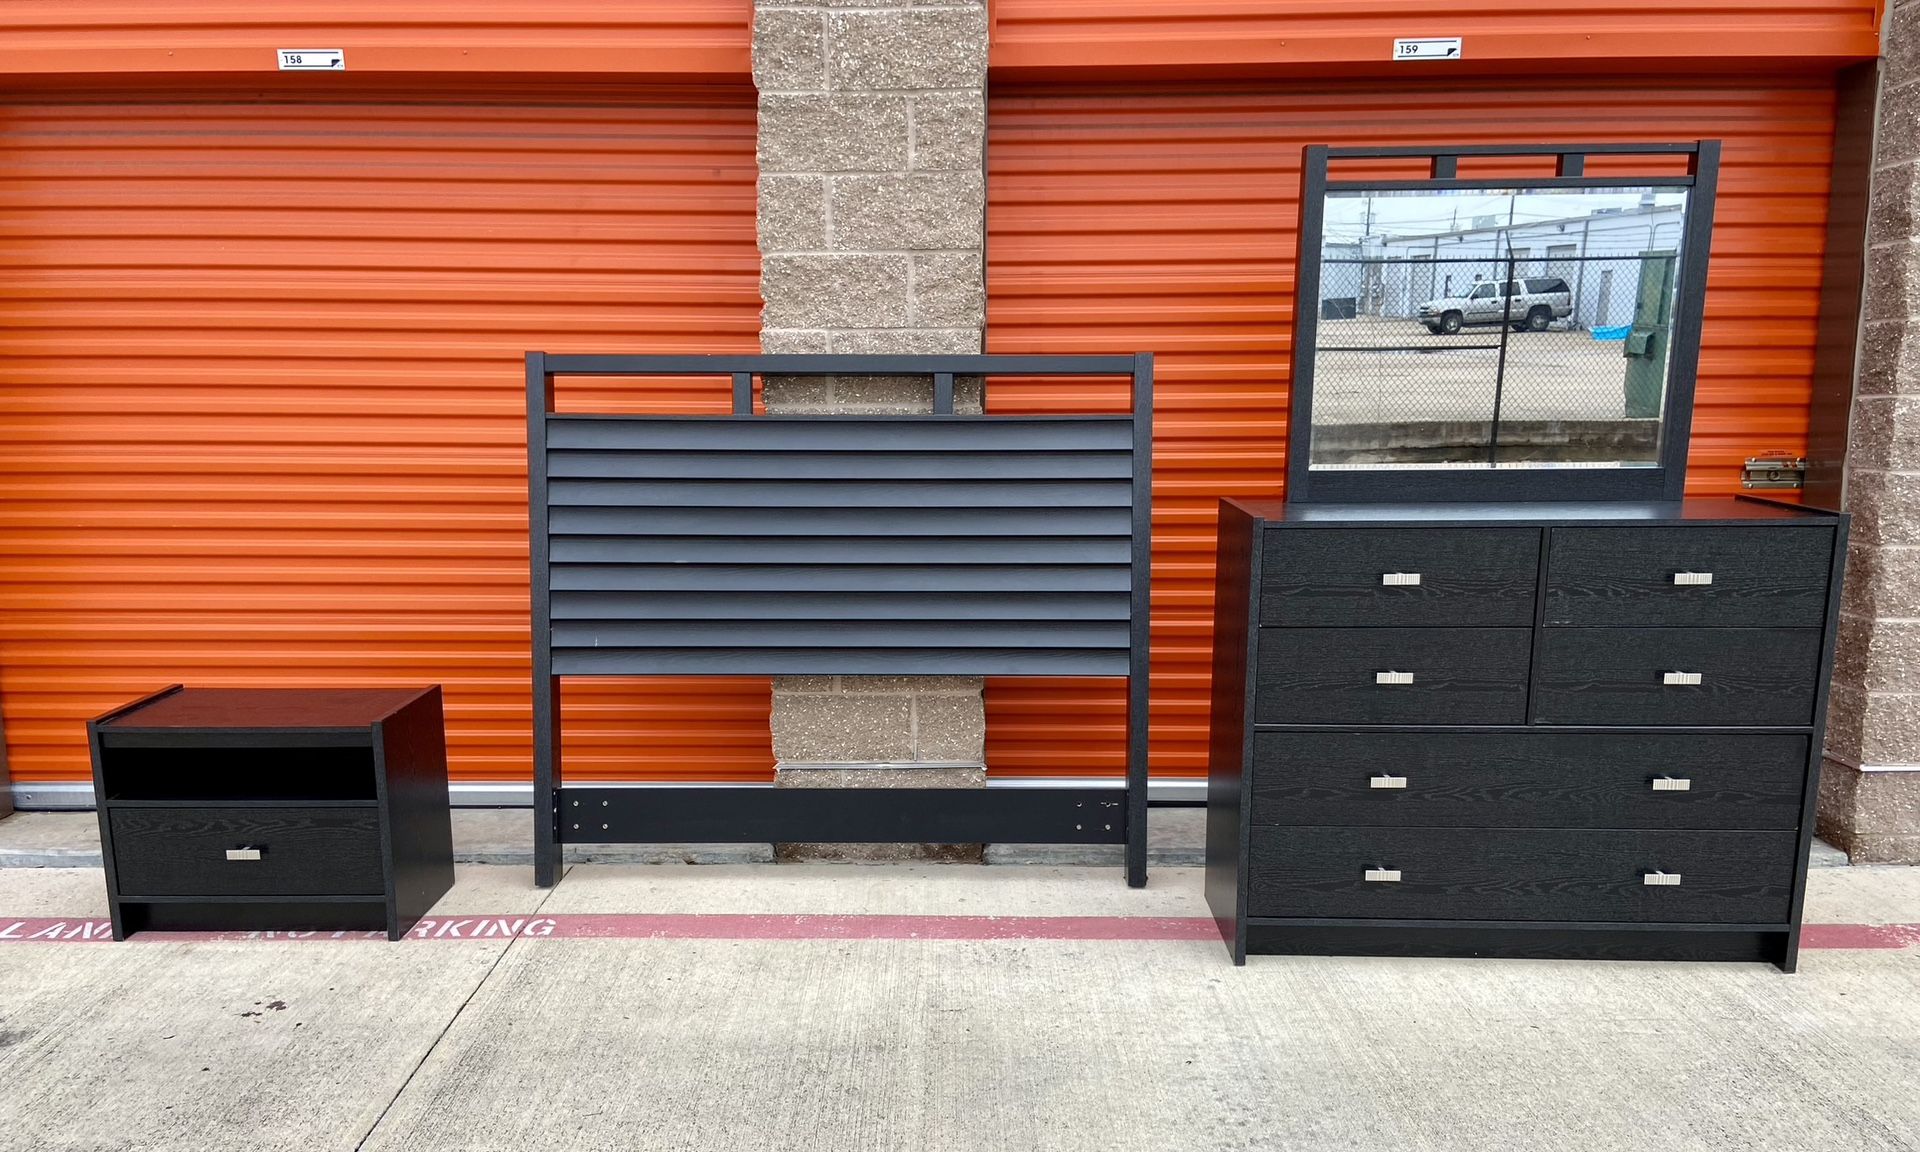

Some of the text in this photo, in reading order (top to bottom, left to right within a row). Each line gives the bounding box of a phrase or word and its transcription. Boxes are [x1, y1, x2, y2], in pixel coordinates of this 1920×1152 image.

[1400, 45, 1418, 54] 159
[284, 55, 302, 64] 158
[0, 918, 556, 939] LAN RKING
